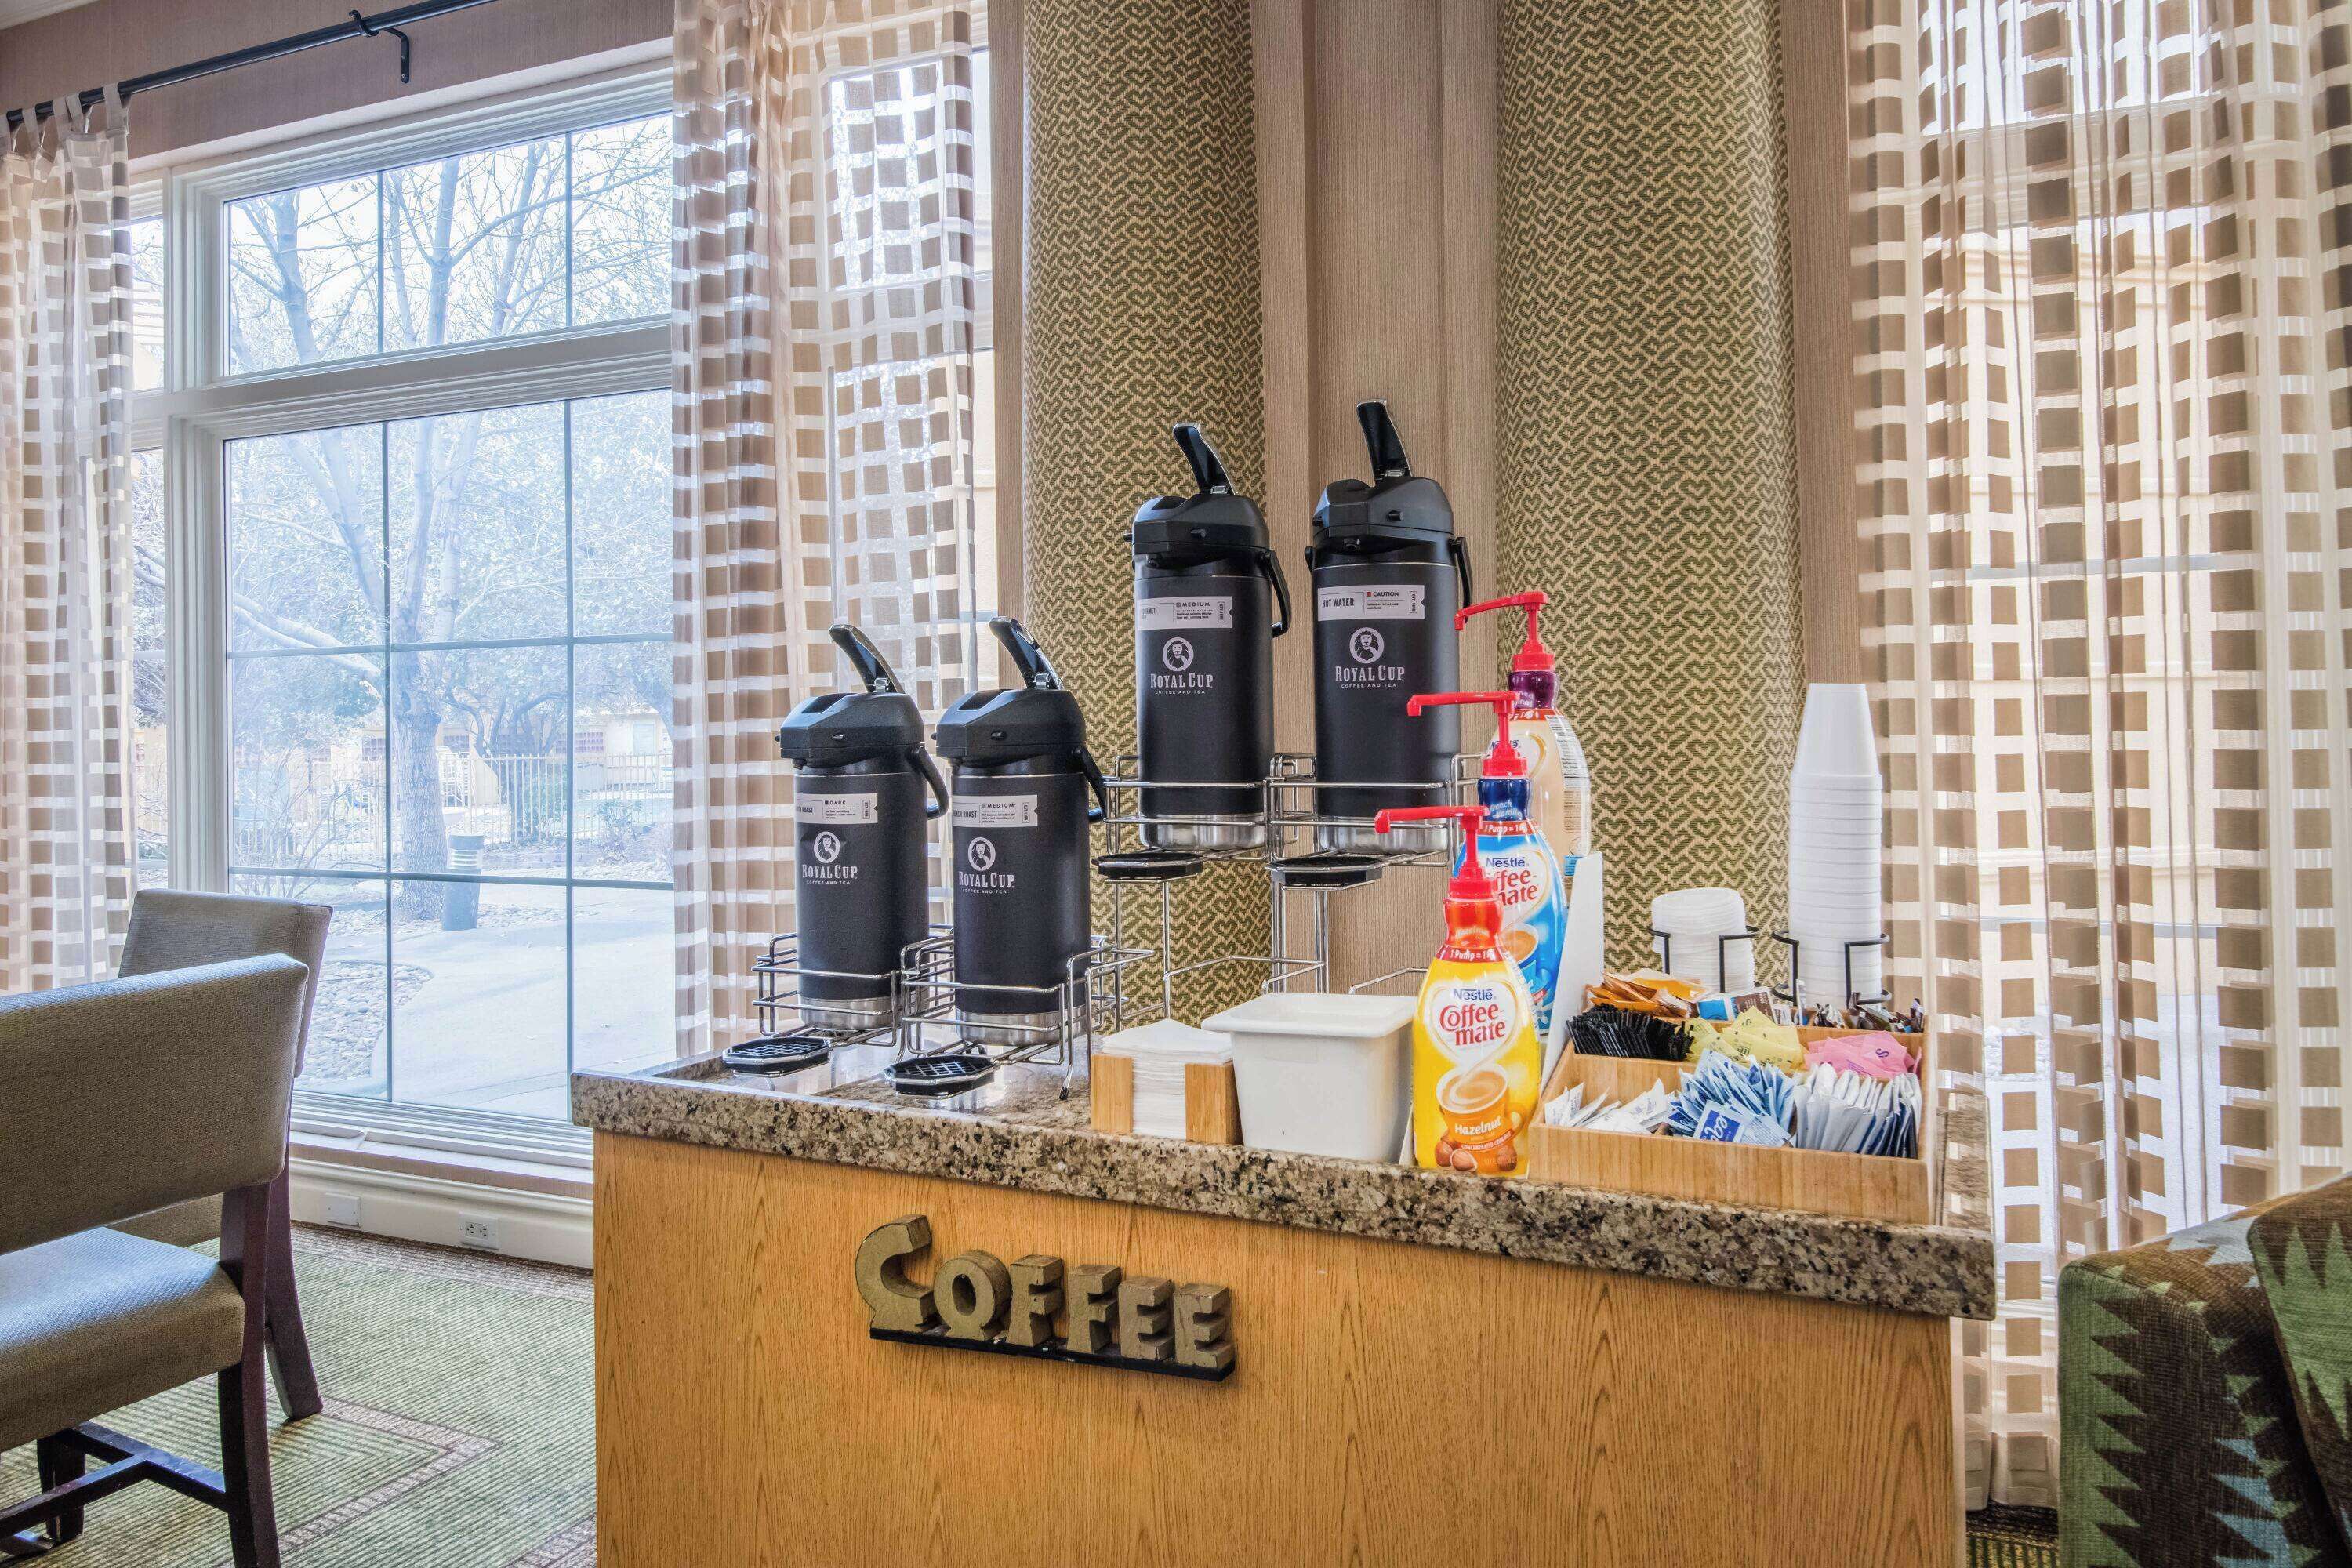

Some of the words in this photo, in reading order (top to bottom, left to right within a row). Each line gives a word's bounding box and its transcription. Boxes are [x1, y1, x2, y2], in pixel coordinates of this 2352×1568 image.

[1322, 599, 1331, 608] HOT
[1333, 597, 1354, 607] WATER
[1150, 673, 1185, 688] ROYAL
[1188, 673, 1214, 688] CUP
[1335, 666, 1375, 681] ROYAL
[1377, 665, 1405, 681] CUP
[802, 864, 833, 879] ROYAL
[834, 864, 858, 879] CUP
[958, 870, 988, 887] ROYAL
[990, 872, 1014, 887] CUP
[1454, 1019, 1506, 1046] mate
[1454, 1115, 1502, 1136] Hazelnut
[855, 1214, 1235, 1369] COFFEE
